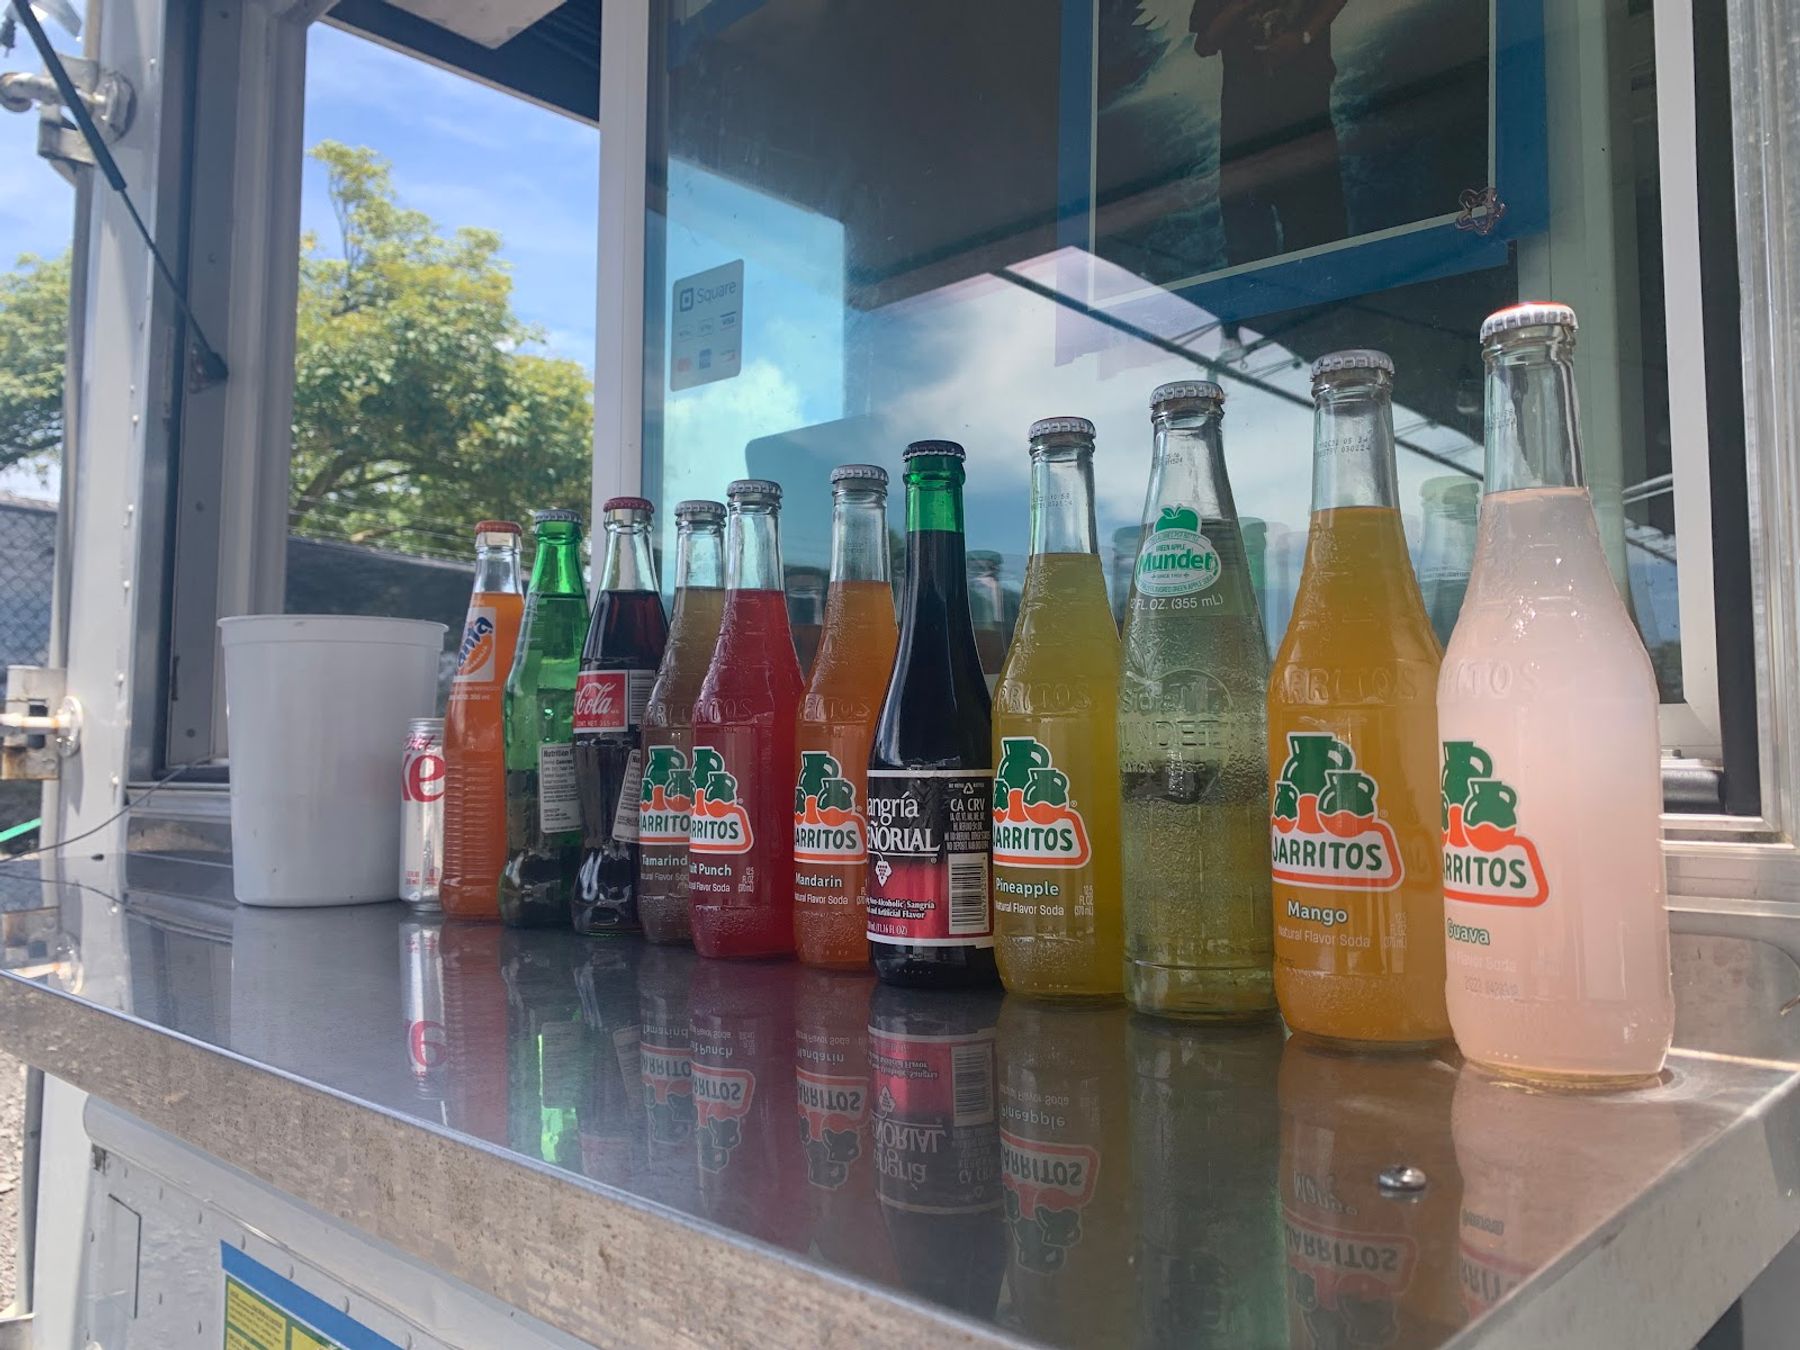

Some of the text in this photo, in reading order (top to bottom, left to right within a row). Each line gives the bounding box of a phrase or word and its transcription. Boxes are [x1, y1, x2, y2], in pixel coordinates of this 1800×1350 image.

[697, 281, 737, 303] Square
[1141, 548, 1212, 571] Mundet
[1171, 597, 1198, 609] (355
[1202, 593, 1223, 607] mL)
[458, 616, 493, 668] anta
[576, 682, 616, 716] Cola
[867, 791, 920, 826] angría
[951, 798, 985, 812] CA CRV
[796, 828, 857, 850] ARRITOS
[642, 854, 688, 866] Tamarind
[1272, 836, 1382, 871] JARRITOS
[699, 863, 732, 876] Punch
[796, 871, 842, 888] Mandarin
[1443, 852, 1527, 889] RRITOS
[713, 883, 731, 893] Soda
[996, 877, 1059, 898] Pineapple
[807, 893, 827, 905] Flavor
[828, 895, 849, 906] Soda
[1013, 901, 1037, 915] Flavor
[1039, 903, 1065, 917] Soda
[902, 910, 926, 919] Flavor
[1288, 899, 1348, 926] Mango
[1304, 929, 1335, 946] Flavor
[1339, 934, 1371, 949] Soda
[1446, 917, 1490, 946] Guava
